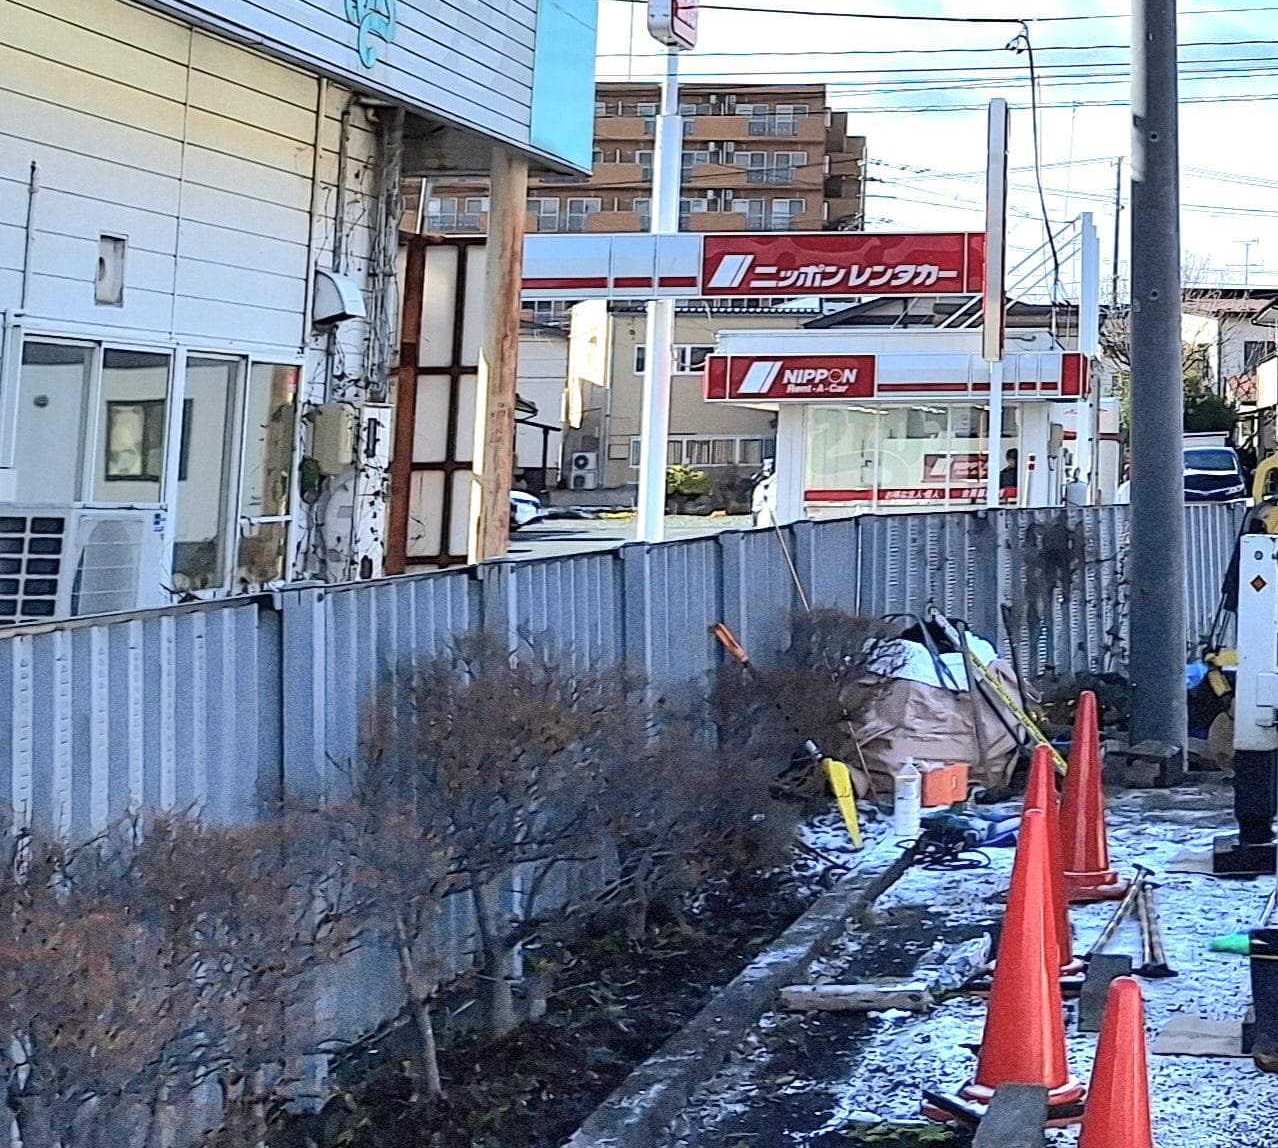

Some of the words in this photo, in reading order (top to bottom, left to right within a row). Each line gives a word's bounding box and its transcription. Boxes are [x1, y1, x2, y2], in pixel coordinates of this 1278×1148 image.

[750, 263, 958, 288] ニッポンレンタカー
[782, 368, 858, 384] NIPPON
[786, 384, 849, 394] Rent-A-Car
